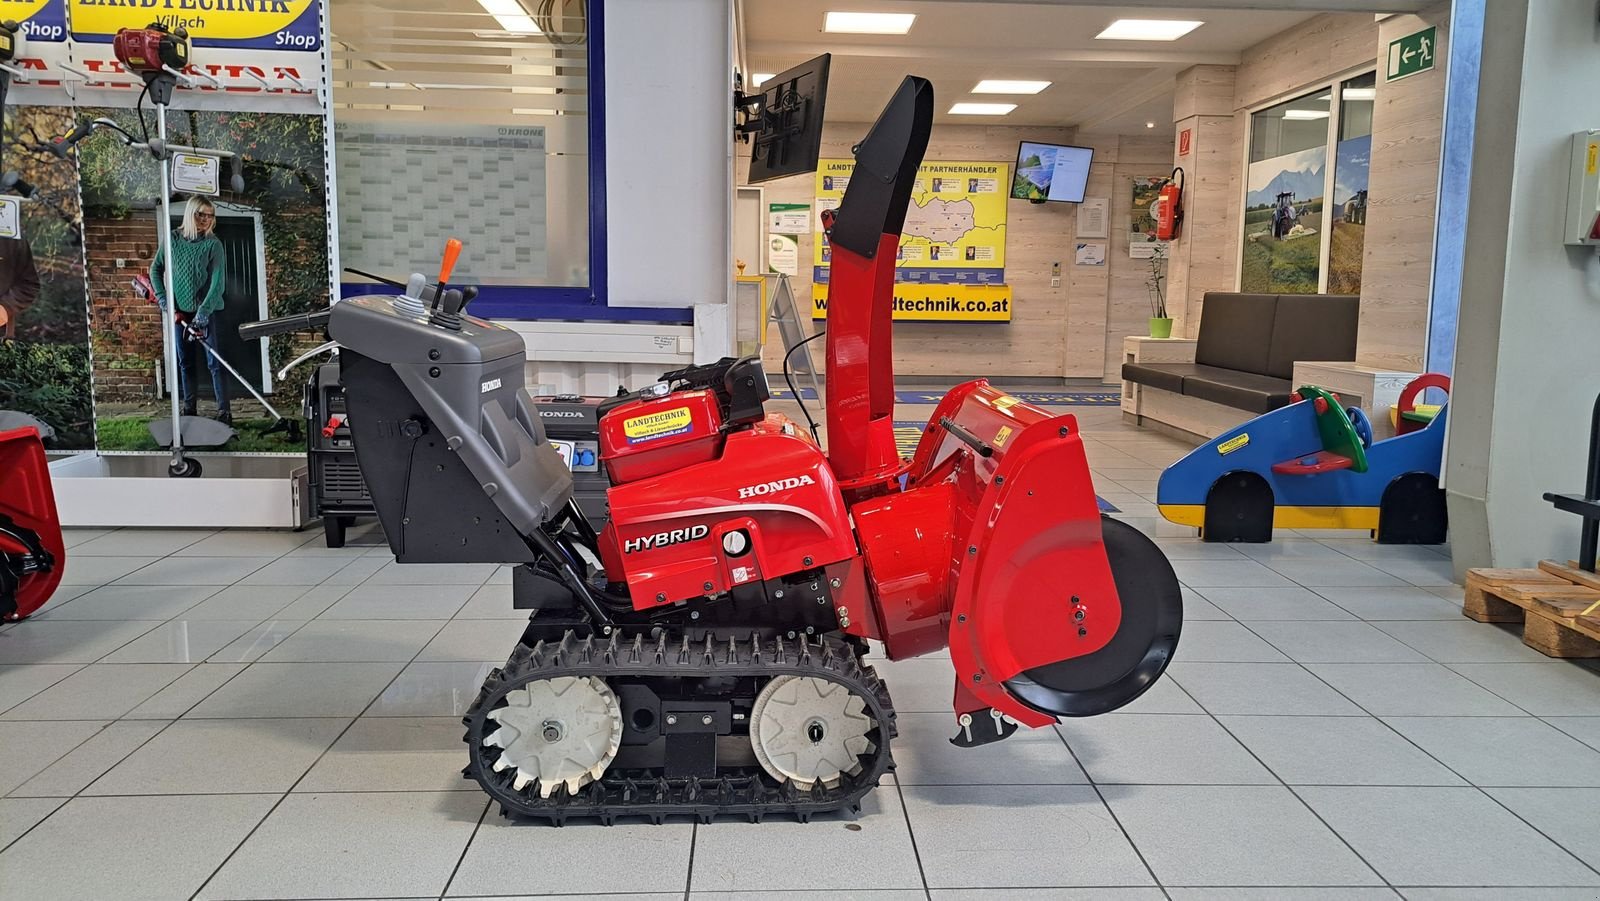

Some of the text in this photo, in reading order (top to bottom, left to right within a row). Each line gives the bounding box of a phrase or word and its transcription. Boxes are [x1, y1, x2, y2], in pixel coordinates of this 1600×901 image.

[156, 14, 205, 28] Villach
[21, 21, 62, 39] Shop
[275, 31, 316, 48] Shop
[507, 129, 544, 137] KRONE
[481, 378, 502, 393] HONDA
[626, 409, 687, 428] LANDTECHNIK
[737, 474, 816, 499] HONDA
[624, 524, 709, 553] HYBRID
